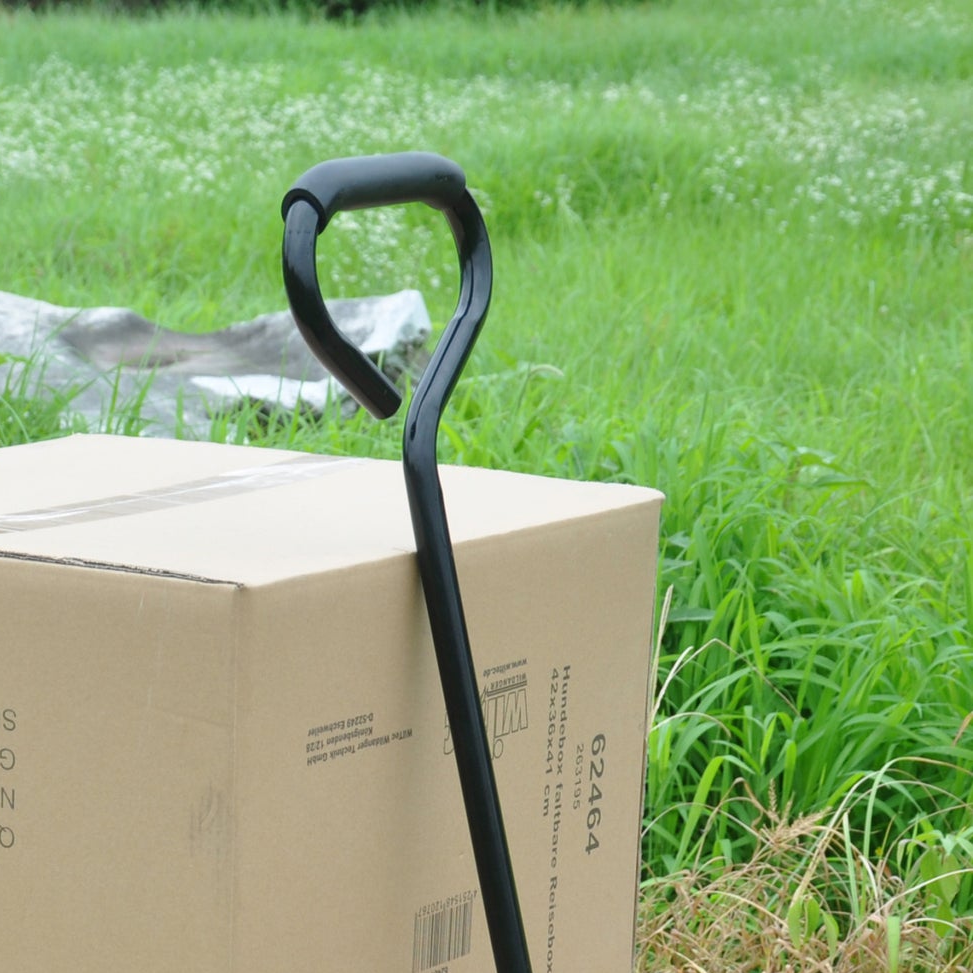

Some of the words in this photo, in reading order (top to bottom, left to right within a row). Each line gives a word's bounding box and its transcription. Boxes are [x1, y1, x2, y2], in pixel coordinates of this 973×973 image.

[490, 673, 527, 689] WILDANGER
[308, 716, 346, 737] Eschweiler
[544, 668, 559, 775] 42x36x41
[556, 665, 571, 776] Hundebox
[306, 750, 328, 766] GmbH
[329, 743, 356, 760] Technik
[357, 733, 391, 752] Wildanger
[573, 743, 584, 810] 263195
[542, 784, 551, 817] cm
[585, 733, 606, 855] 62464
[551, 783, 564, 869] faltbare
